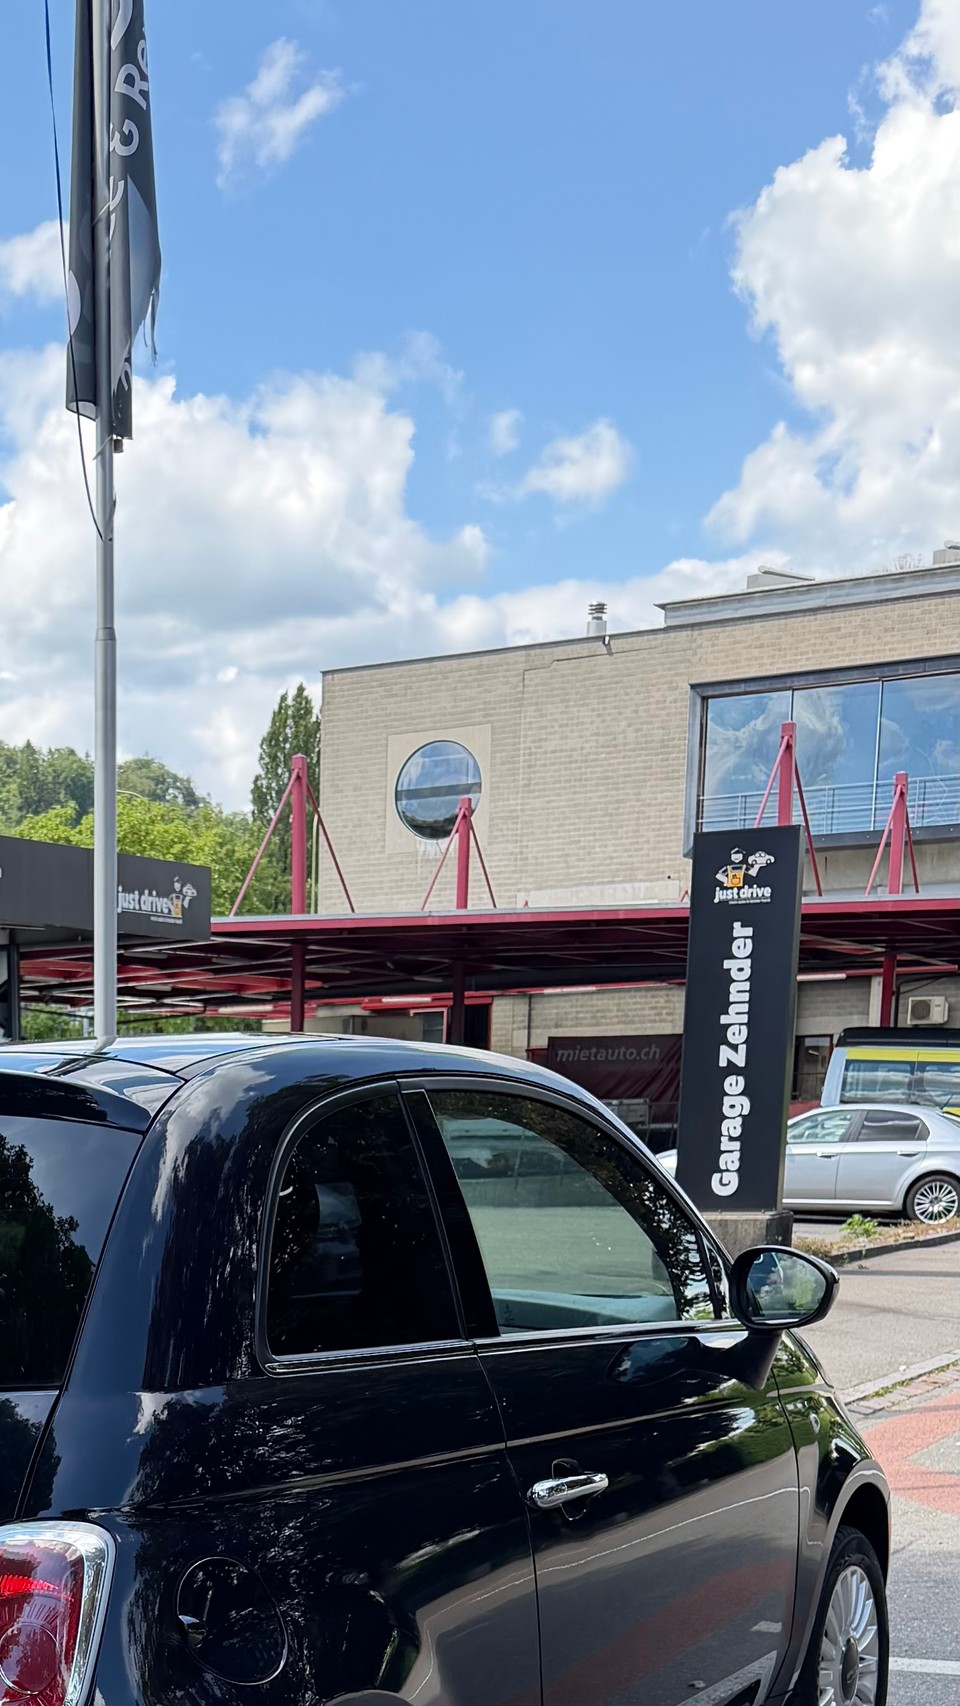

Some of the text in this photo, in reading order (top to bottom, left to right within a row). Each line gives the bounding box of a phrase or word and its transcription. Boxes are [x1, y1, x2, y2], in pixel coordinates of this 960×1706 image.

[117, 885, 169, 914] just drive
[713, 886, 738, 904] just
[739, 884, 772, 899] drive
[719, 921, 754, 1068] Zehnder
[556, 1044, 660, 1062] mietauto.ch
[711, 1075, 751, 1197] Garage
